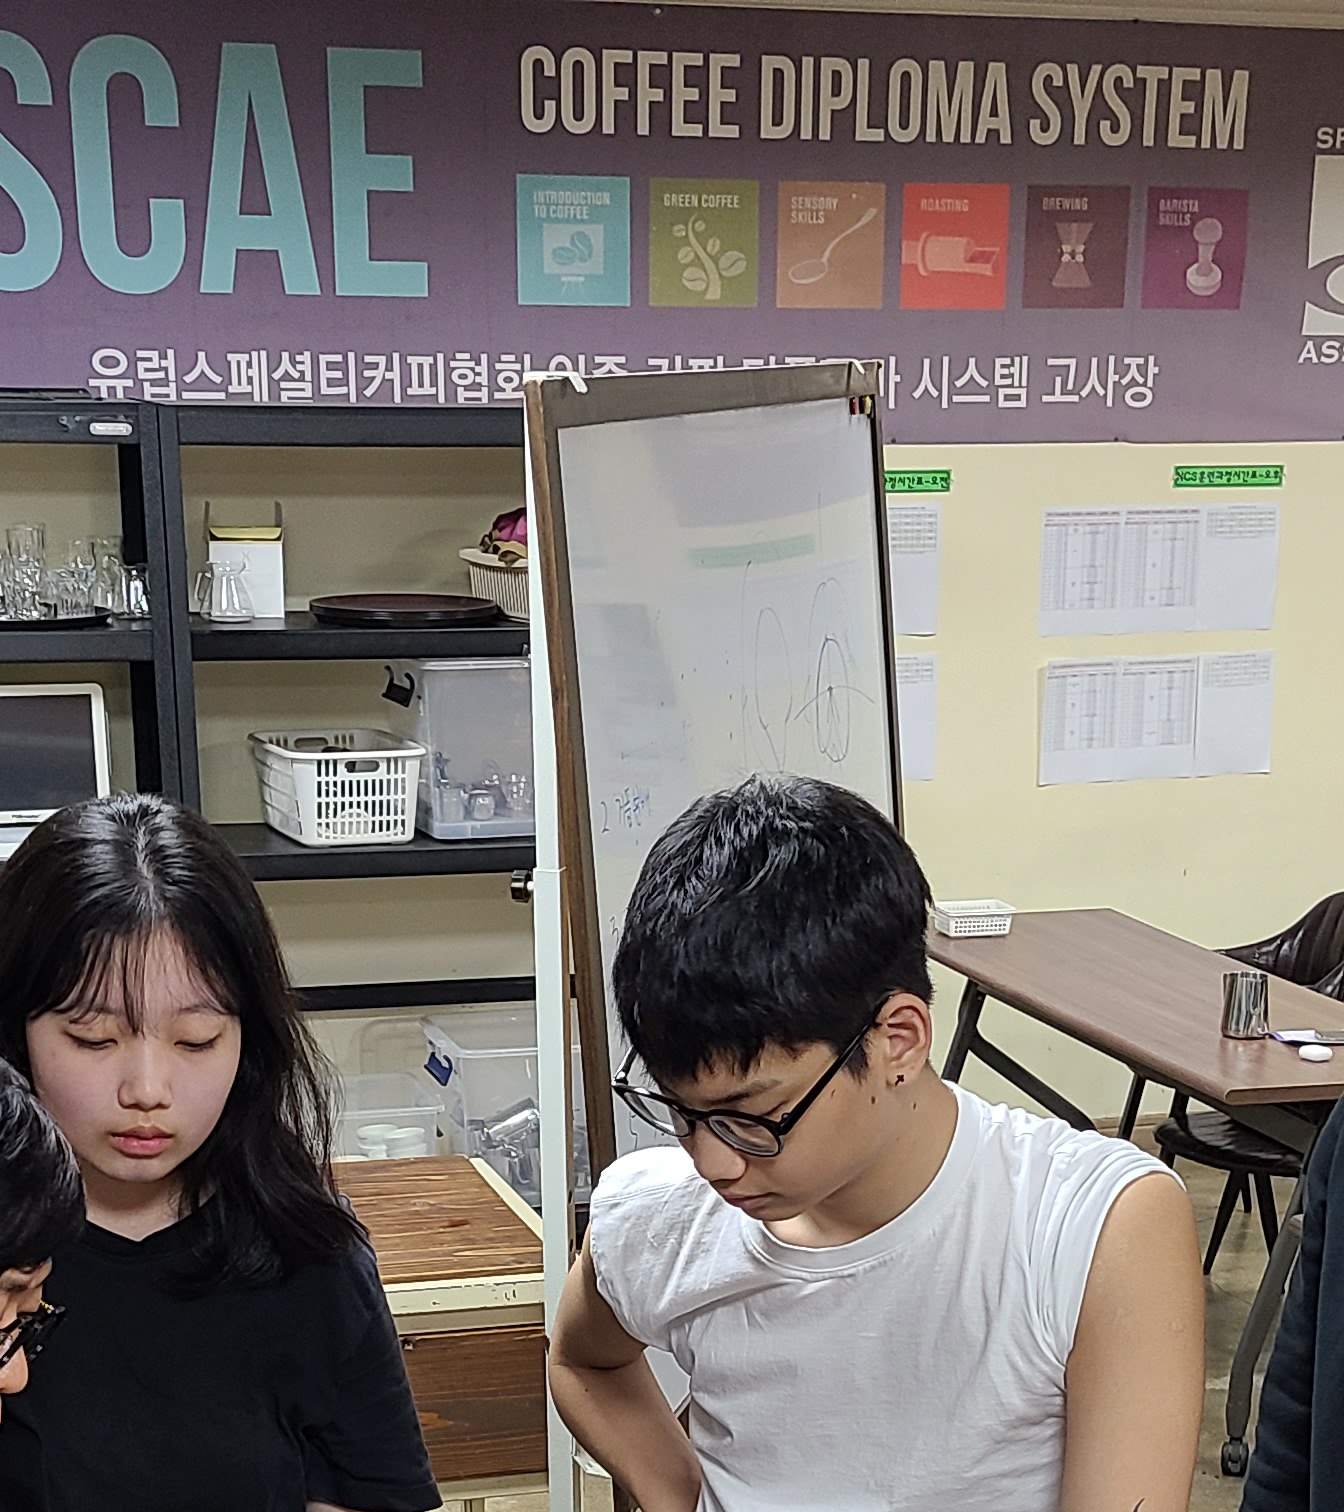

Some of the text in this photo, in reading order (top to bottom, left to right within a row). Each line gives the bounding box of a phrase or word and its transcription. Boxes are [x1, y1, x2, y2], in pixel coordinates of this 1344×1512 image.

[520, 45, 1250, 150] COFFEE DIPLOMA SYSTEM
[533, 190, 611, 206] INTRODUCTION
[664, 193, 740, 209] GREEN COFFEE
[791, 196, 839, 211] SENSORY
[920, 198, 969, 213] ROASTING
[1042, 197, 1088, 211] BREWING
[534, 205, 590, 220] TO COFFEE
[1159, 199, 1199, 213] BARISTA
[791, 210, 825, 224] SKILLS
[1159, 212, 1191, 226] SKILLS
[88, 347, 531, 404] 유럽스페셜티커피협회
[912, 355, 1030, 408] 시스템
[1041, 355, 1158, 407] 고사장
